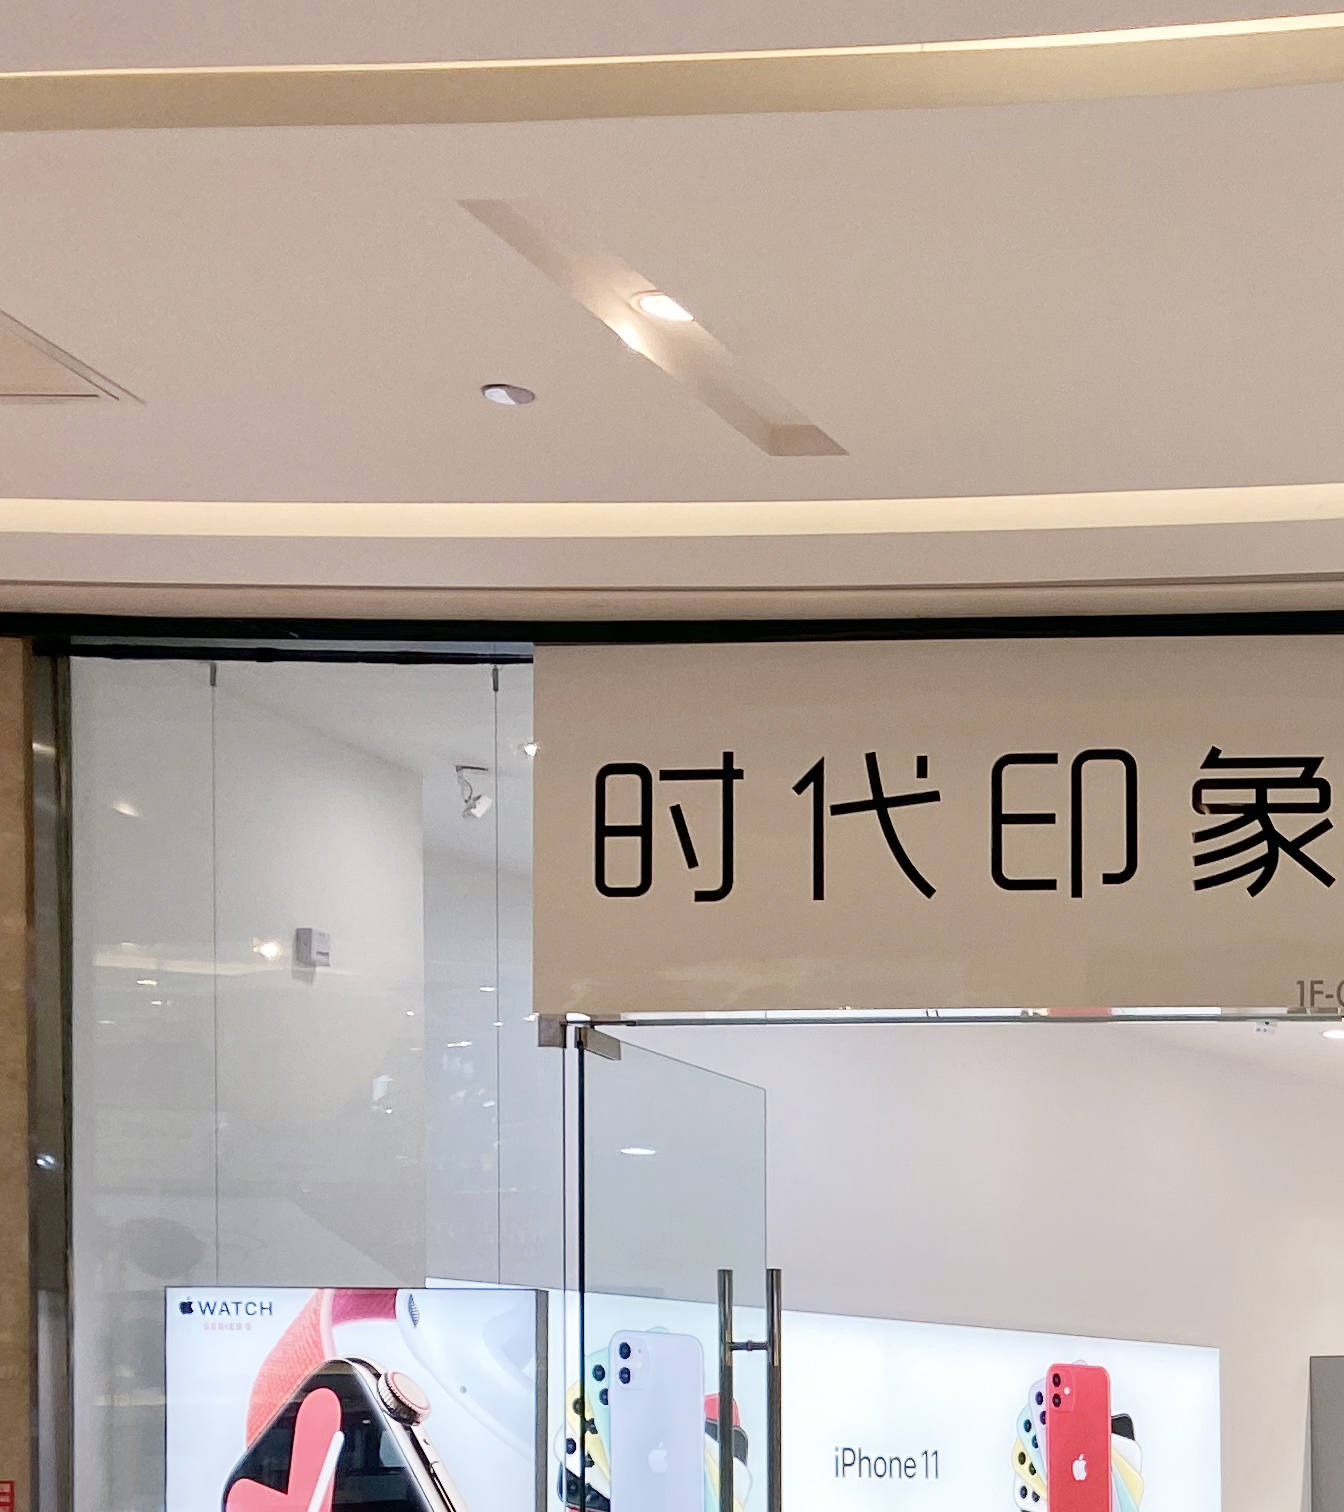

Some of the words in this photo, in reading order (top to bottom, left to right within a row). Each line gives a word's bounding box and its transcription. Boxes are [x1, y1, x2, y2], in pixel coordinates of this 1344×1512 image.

[594, 745, 1336, 903] 时代印象
[197, 1300, 273, 1316] WATCH
[834, 1446, 917, 1479] iPhone
[920, 1449, 939, 1479] 11
